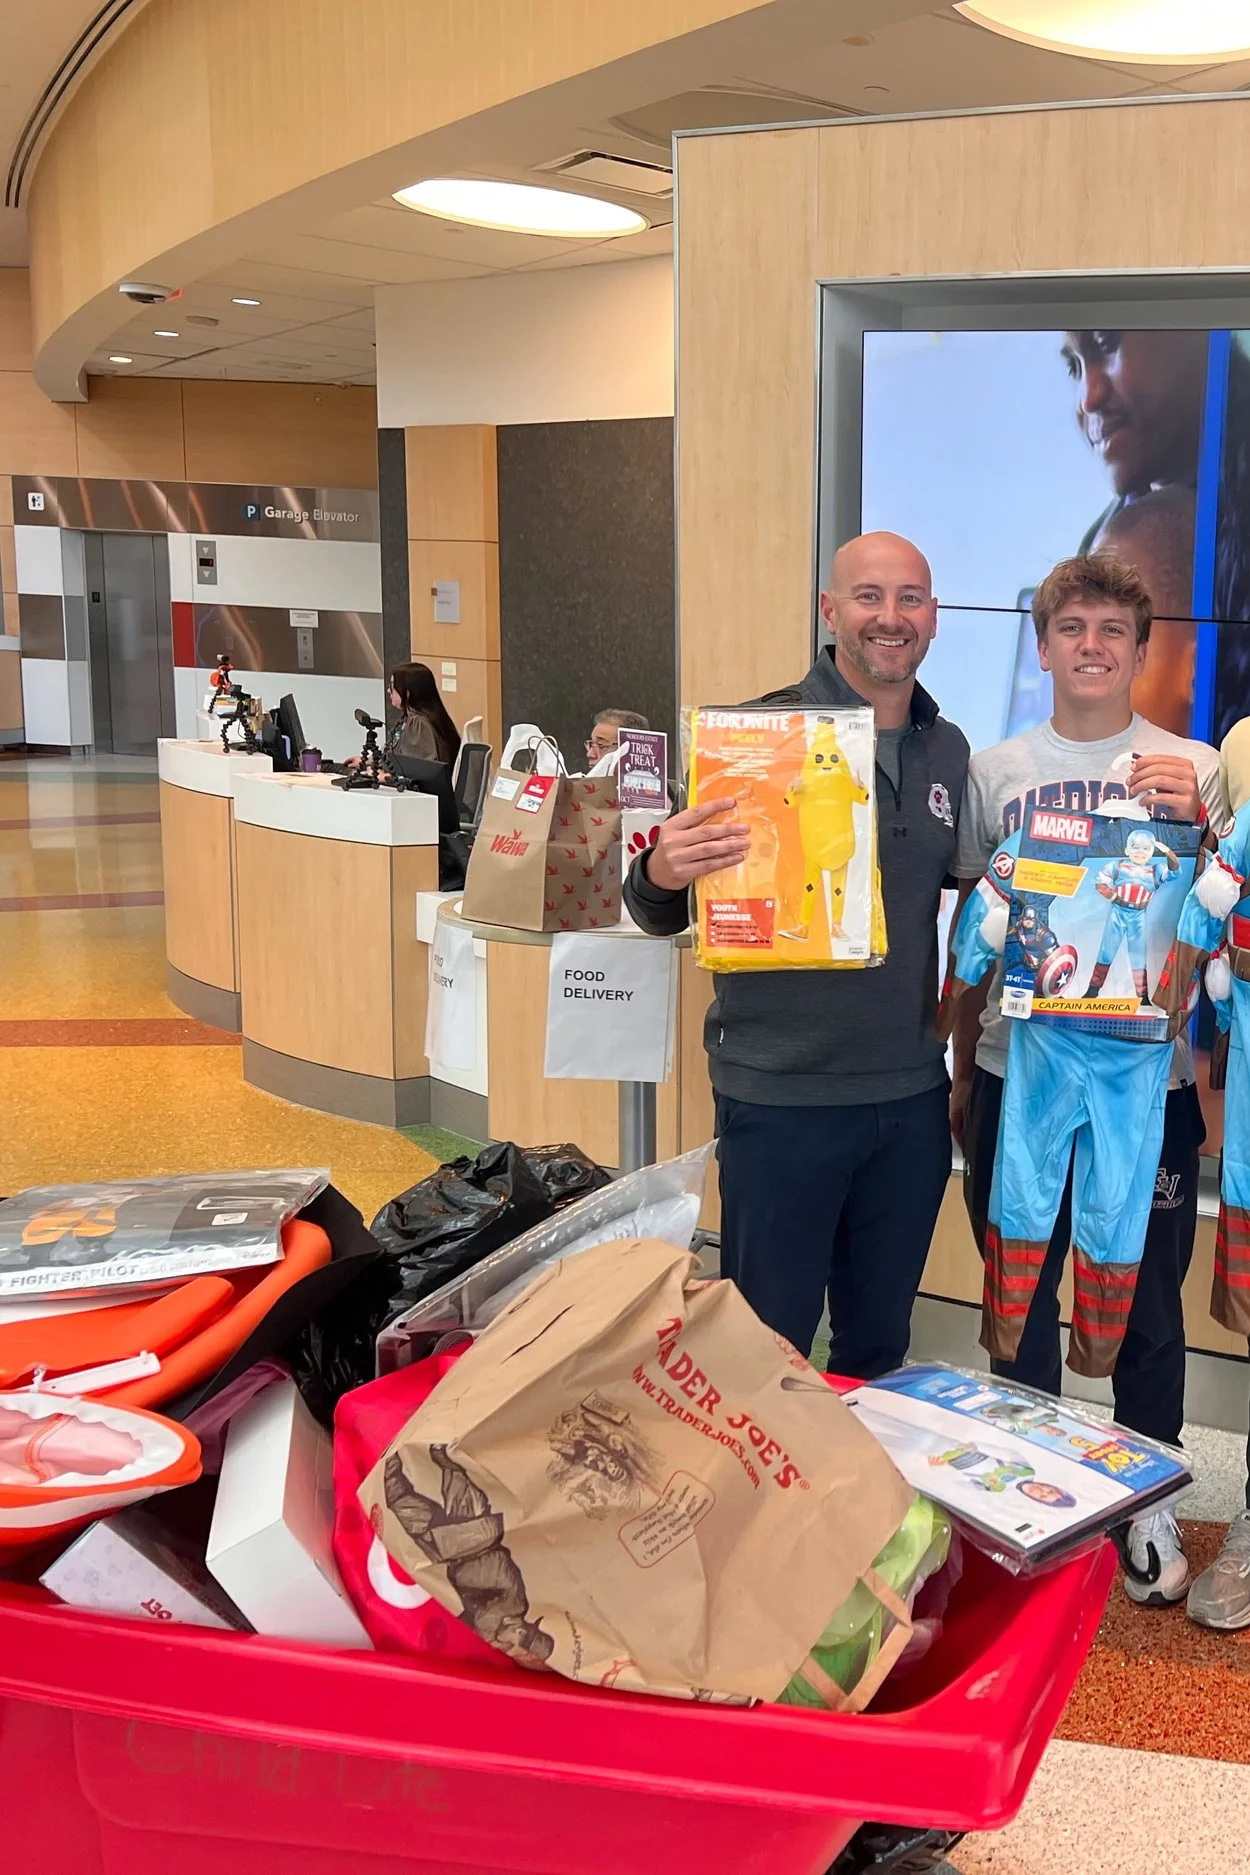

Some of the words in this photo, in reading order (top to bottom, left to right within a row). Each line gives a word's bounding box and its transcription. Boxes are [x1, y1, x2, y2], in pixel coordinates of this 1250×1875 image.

[247, 505, 256, 518] P
[264, 506, 309, 523] Garage
[313, 508, 360, 523] Elevator
[631, 742, 654, 756] TRICK
[629, 753, 657, 767] TREAT
[1033, 814, 1090, 842] MARVEL
[490, 834, 530, 857] Wawa
[711, 903, 738, 912] YOUTH
[711, 913, 752, 922] JEUNESSE
[564, 969, 605, 982] FOOD
[563, 987, 634, 1001] DELIVERY
[1038, 1001, 1082, 1011] CAPTAIN
[1085, 1003, 1131, 1012] AMERICA
[11, 1271, 82, 1288] FIGHTER
[91, 1265, 139, 1279] PILOT
[726, 1413, 801, 1489] JOE'S
